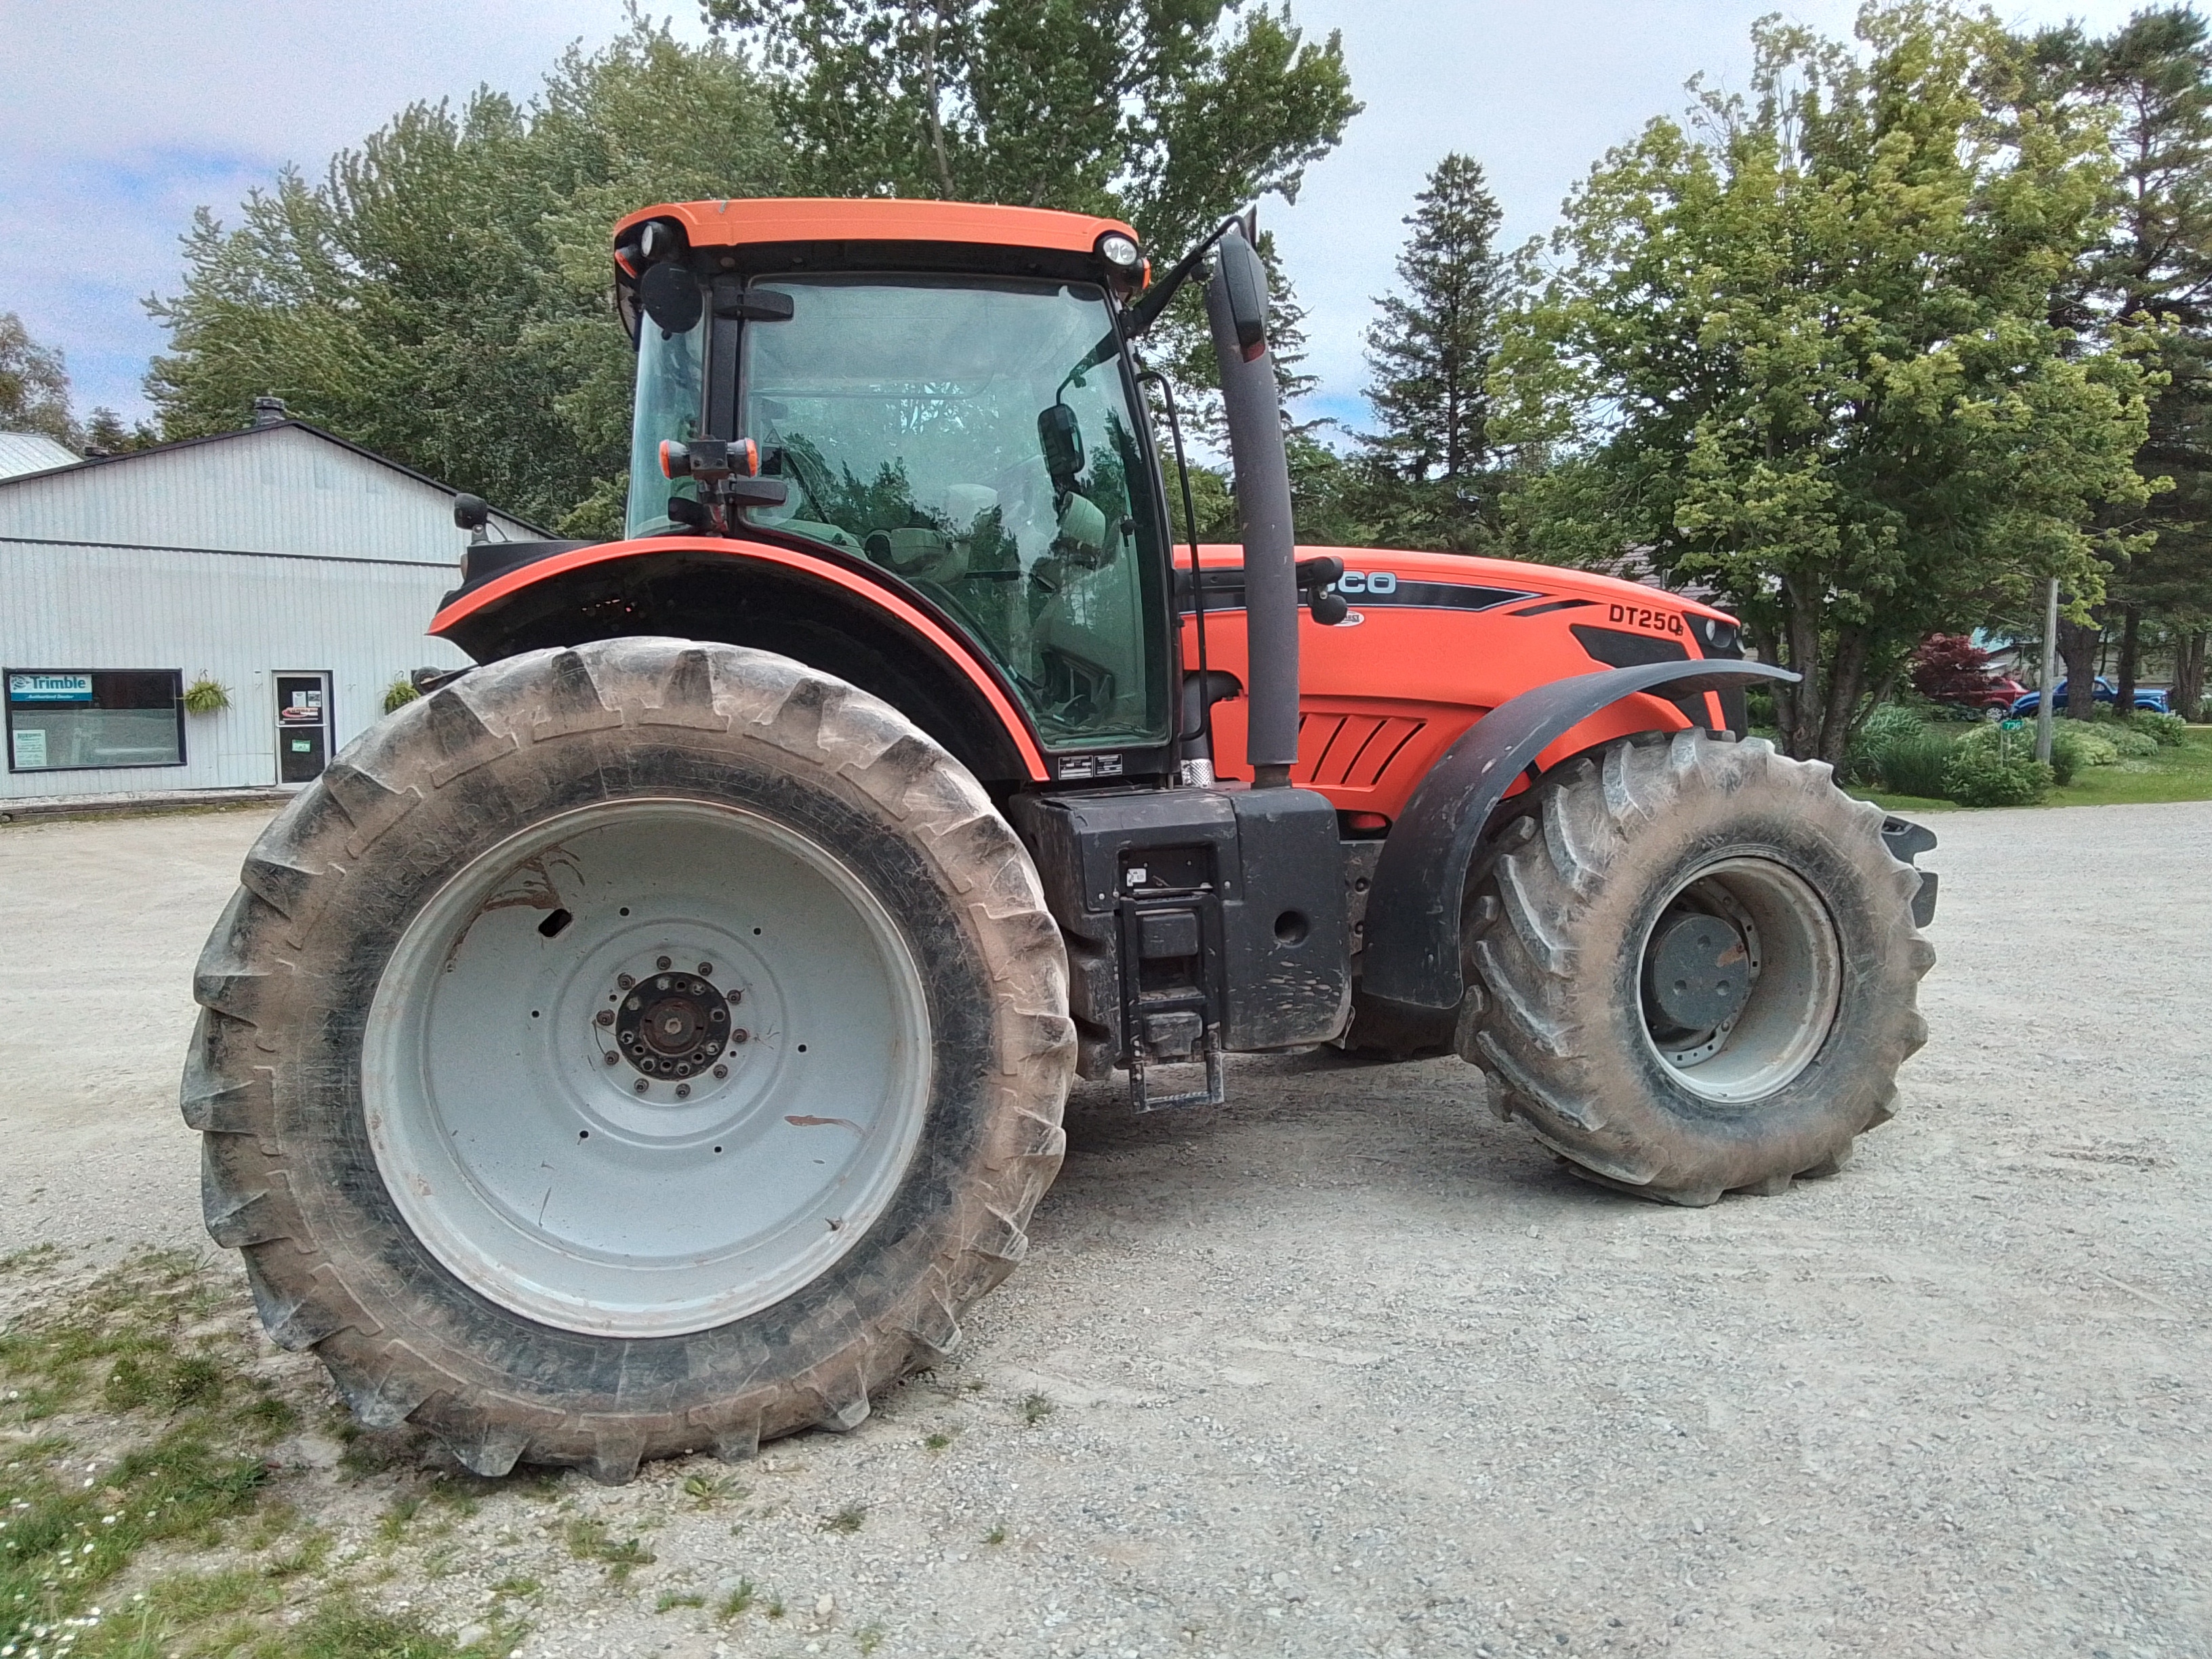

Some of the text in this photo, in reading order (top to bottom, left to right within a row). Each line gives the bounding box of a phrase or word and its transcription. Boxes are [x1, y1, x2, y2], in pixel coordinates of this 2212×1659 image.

[1326, 571, 1397, 594] CO
[29, 676, 86, 689] Trimble
[2005, 722, 2021, 730] 736
